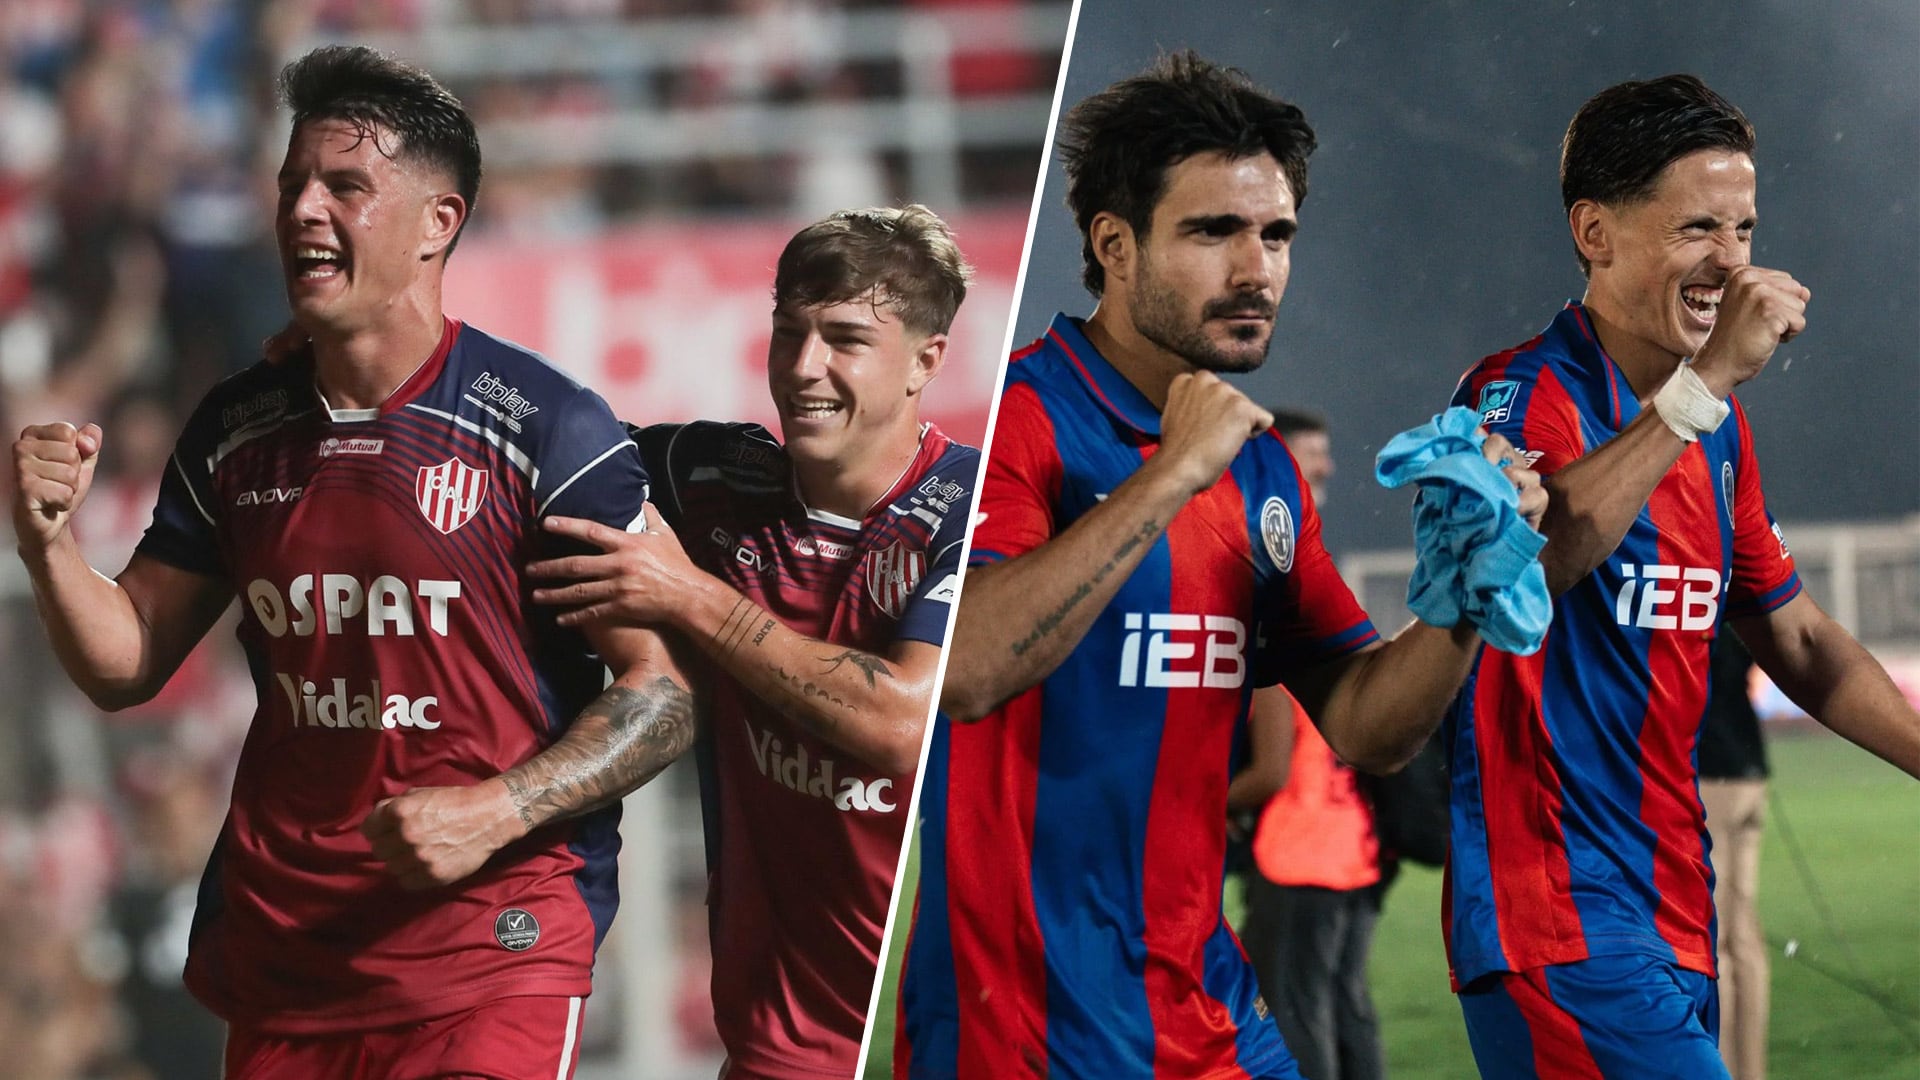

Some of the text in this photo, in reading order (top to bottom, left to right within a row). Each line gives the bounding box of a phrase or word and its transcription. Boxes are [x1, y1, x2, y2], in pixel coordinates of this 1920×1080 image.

[471, 371, 539, 420] bplay
[1483, 407, 1508, 423] PF
[340, 441, 378, 452] Mutual
[236, 486, 303, 506] GIVOVA
[247, 573, 462, 639] OSPAT
[276, 672, 442, 731] Vidalac
